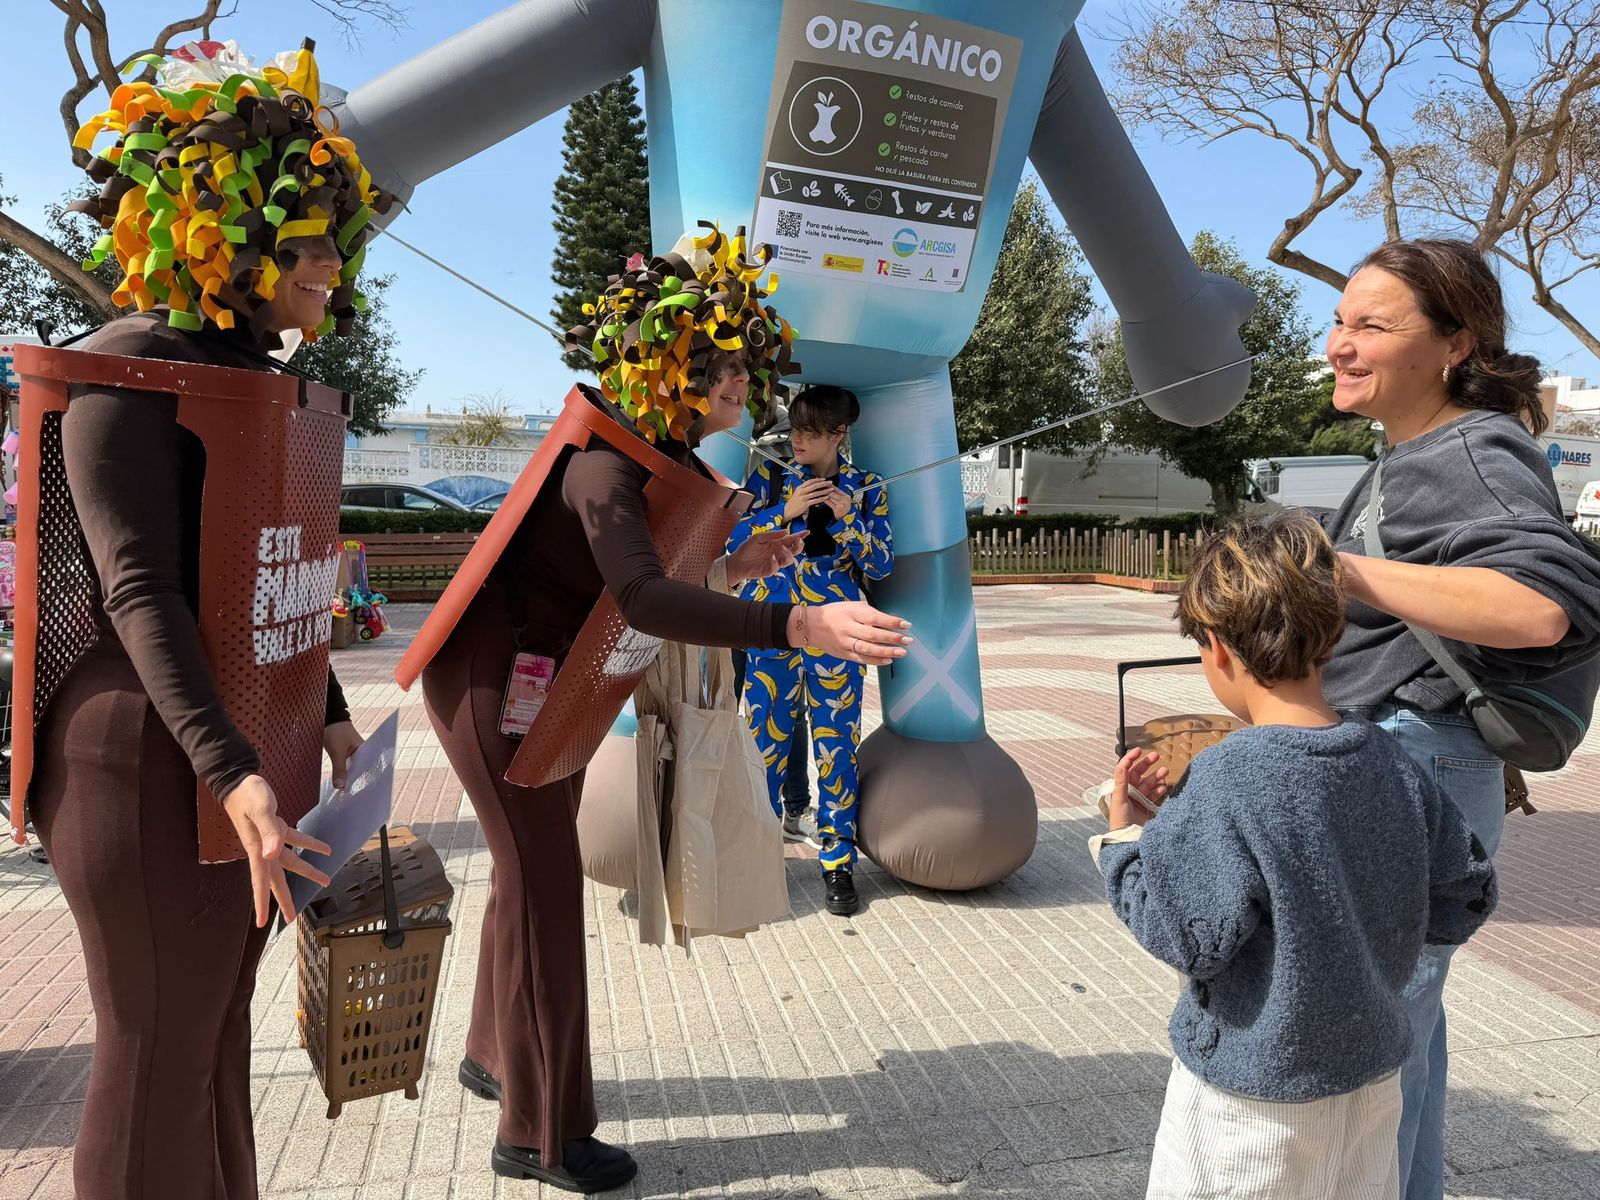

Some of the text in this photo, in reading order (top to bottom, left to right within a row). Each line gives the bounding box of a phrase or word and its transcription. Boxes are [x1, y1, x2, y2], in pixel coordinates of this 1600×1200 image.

[805, 15, 1002, 82] ORGÁNICO
[906, 90, 964, 110] Restos de comida
[901, 111, 959, 130] Pieles y restos de
[899, 120, 956, 140] frutas y verduras
[895, 141, 949, 159] Restos de carne
[899, 155, 929, 166] pescado
[906, 171, 926, 180] BASURA
[927, 174, 941, 183] FUERA
[805, 229, 820, 237] visite
[828, 233, 841, 241] web
[806, 221, 820, 229] Para
[834, 225, 870, 237] información,
[920, 239, 956, 254] ARCGISA
[258, 525, 302, 564] ESTE
[253, 621, 296, 665] VALE
[296, 617, 312, 654] LA
